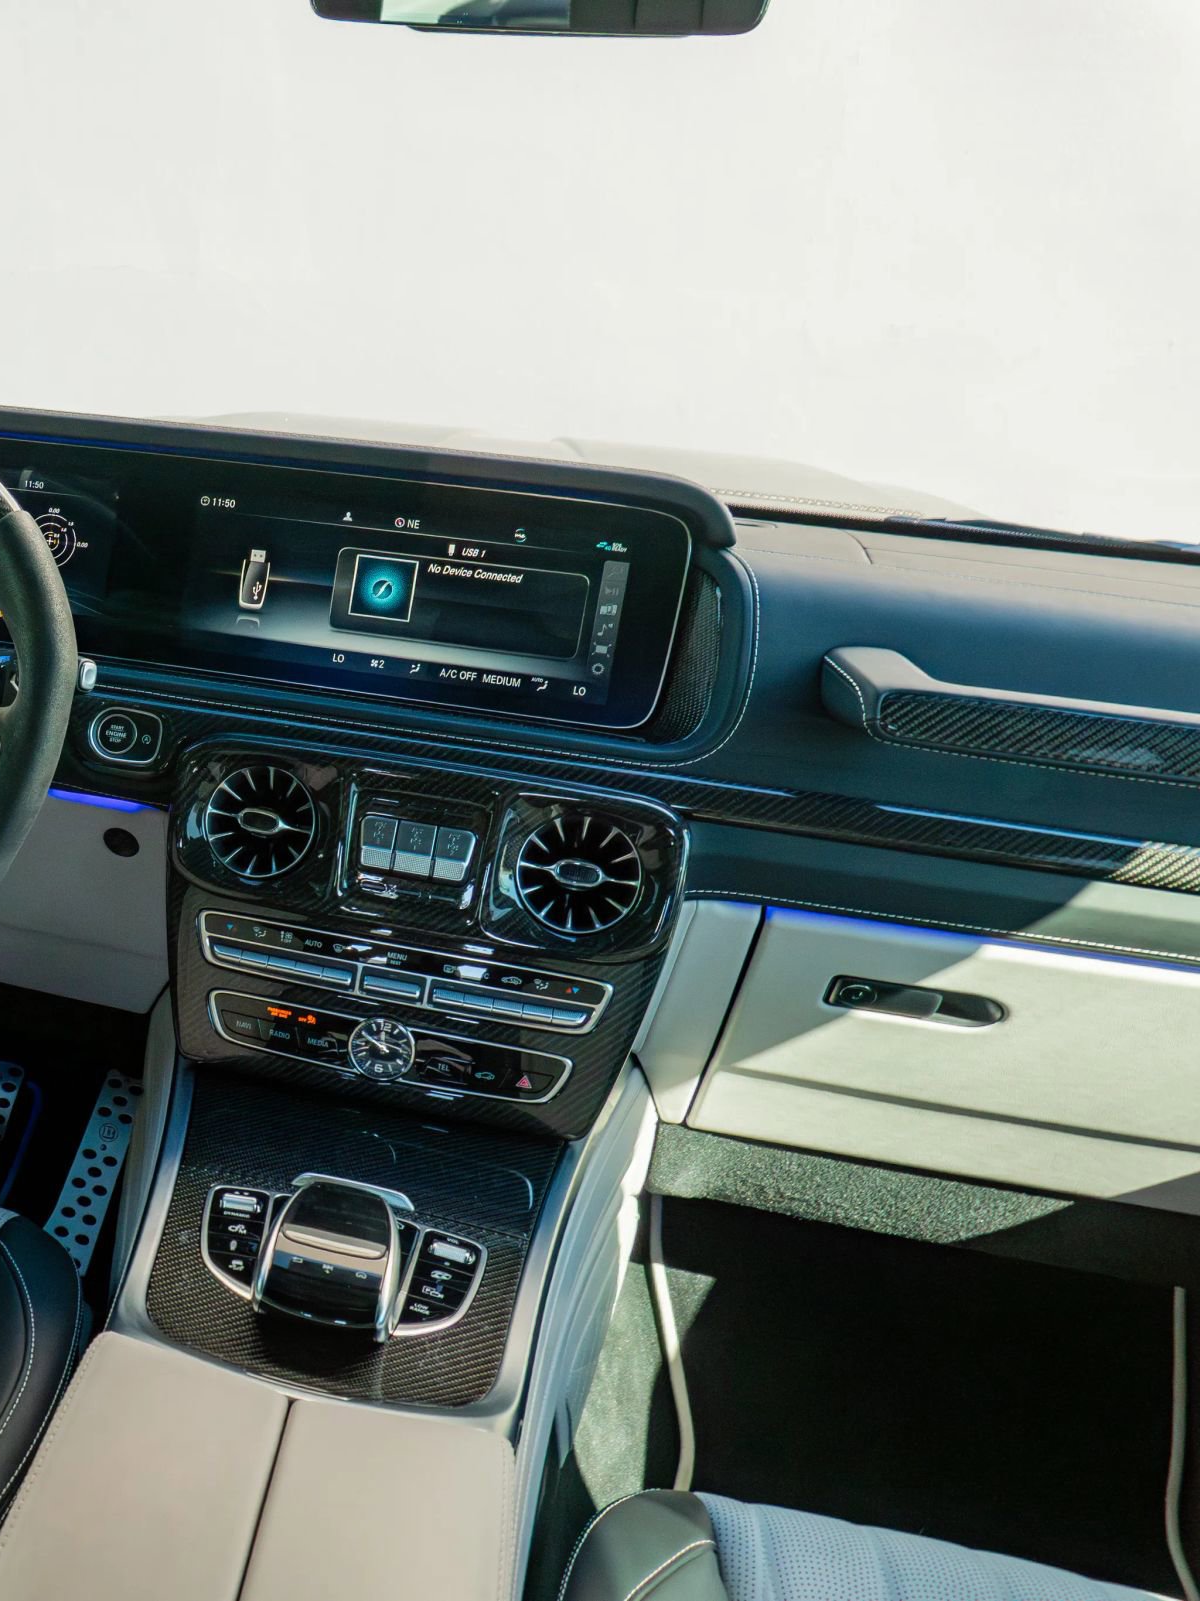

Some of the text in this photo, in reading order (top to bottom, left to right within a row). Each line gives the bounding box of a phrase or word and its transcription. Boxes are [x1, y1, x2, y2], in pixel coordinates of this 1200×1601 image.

[24, 480, 44, 489] 11:50
[212, 497, 236, 508] 11:50
[407, 519, 420, 529] NE
[462, 547, 486, 558] USB 1
[428, 563, 524, 584] No Device Connected
[332, 653, 385, 669] LO 2
[439, 669, 521, 688] A/C OFF MEDIUM
[573, 686, 586, 696] LO
[105, 730, 127, 738] ENGINE
[304, 938, 323, 949] AUTO
[387, 951, 408, 961] MENU
[236, 1020, 252, 1030] NAVI
[380, 1022, 392, 1032] 12
[269, 1029, 290, 1040] RADIO
[307, 1037, 329, 1048] MEDIA
[374, 1064, 383, 1073] 6
[437, 1063, 449, 1072] TEL
